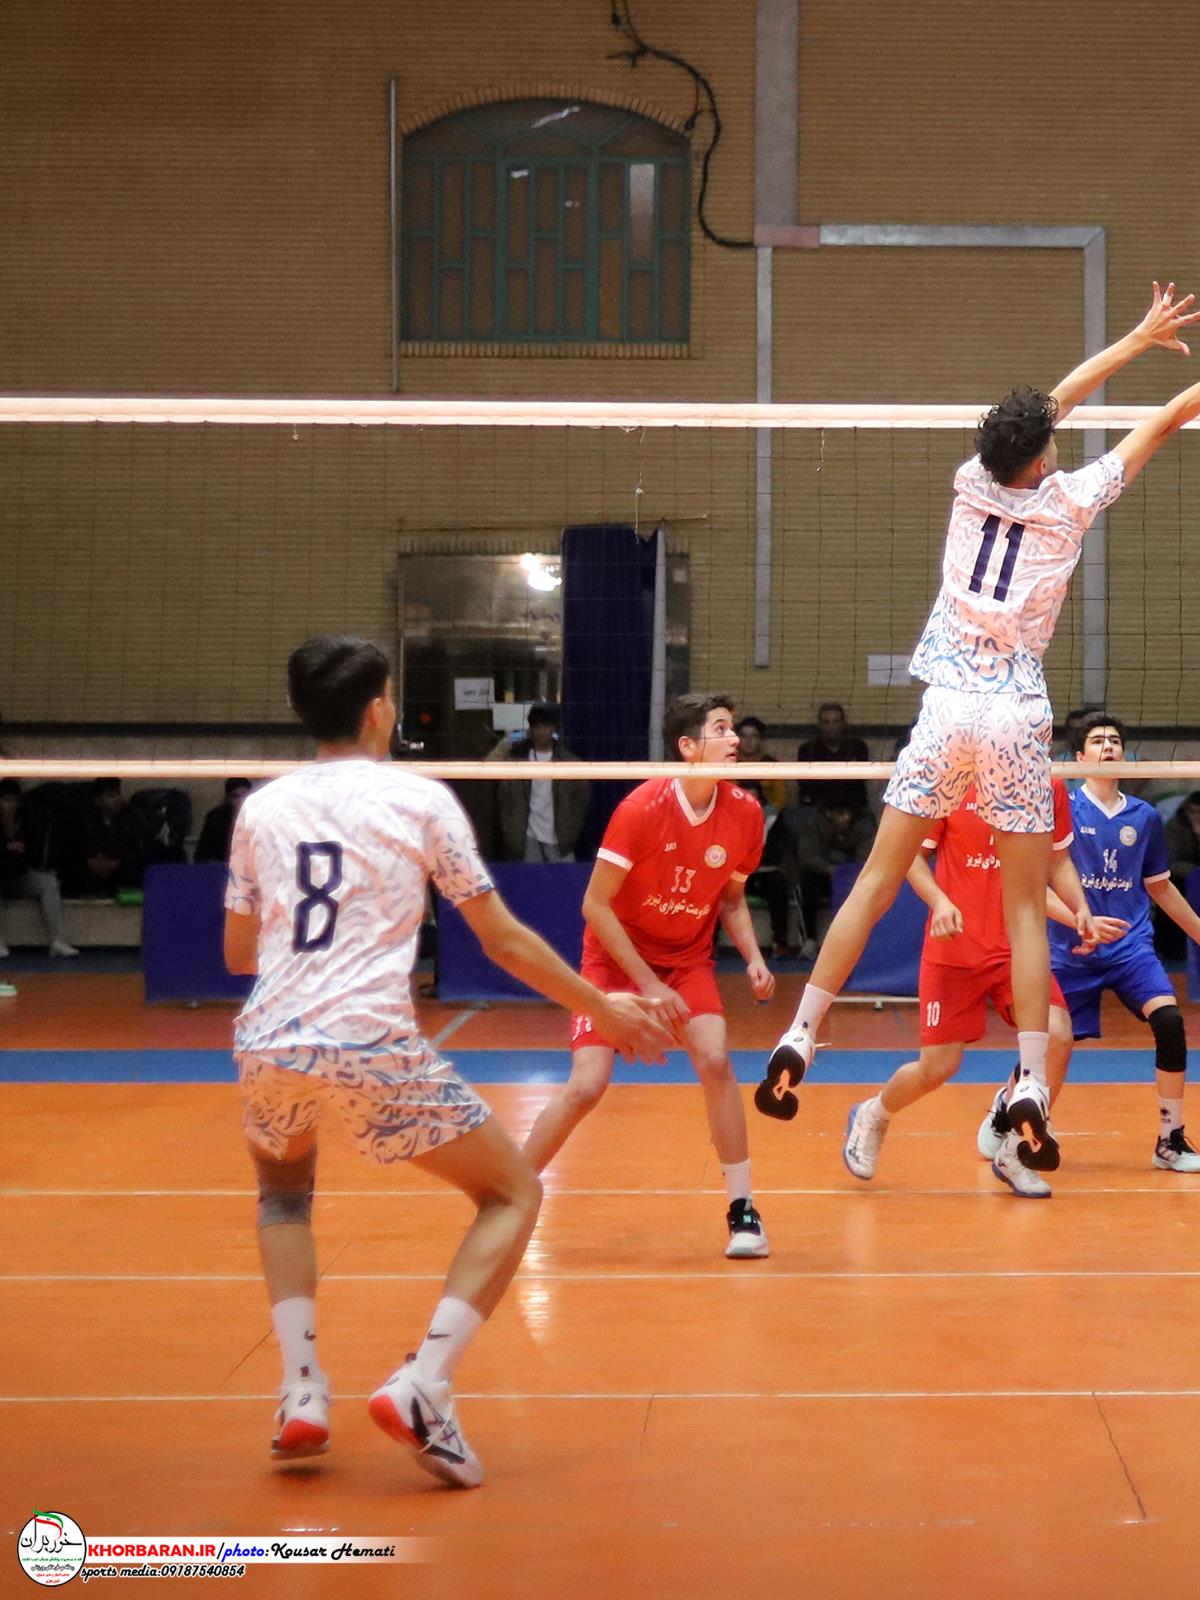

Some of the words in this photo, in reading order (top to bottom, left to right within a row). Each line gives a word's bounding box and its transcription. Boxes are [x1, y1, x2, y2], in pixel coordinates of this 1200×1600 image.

[968, 514, 1025, 602] 11
[1103, 848, 1118, 873] 14
[291, 840, 342, 956] 8
[927, 1001, 940, 1027] 10
